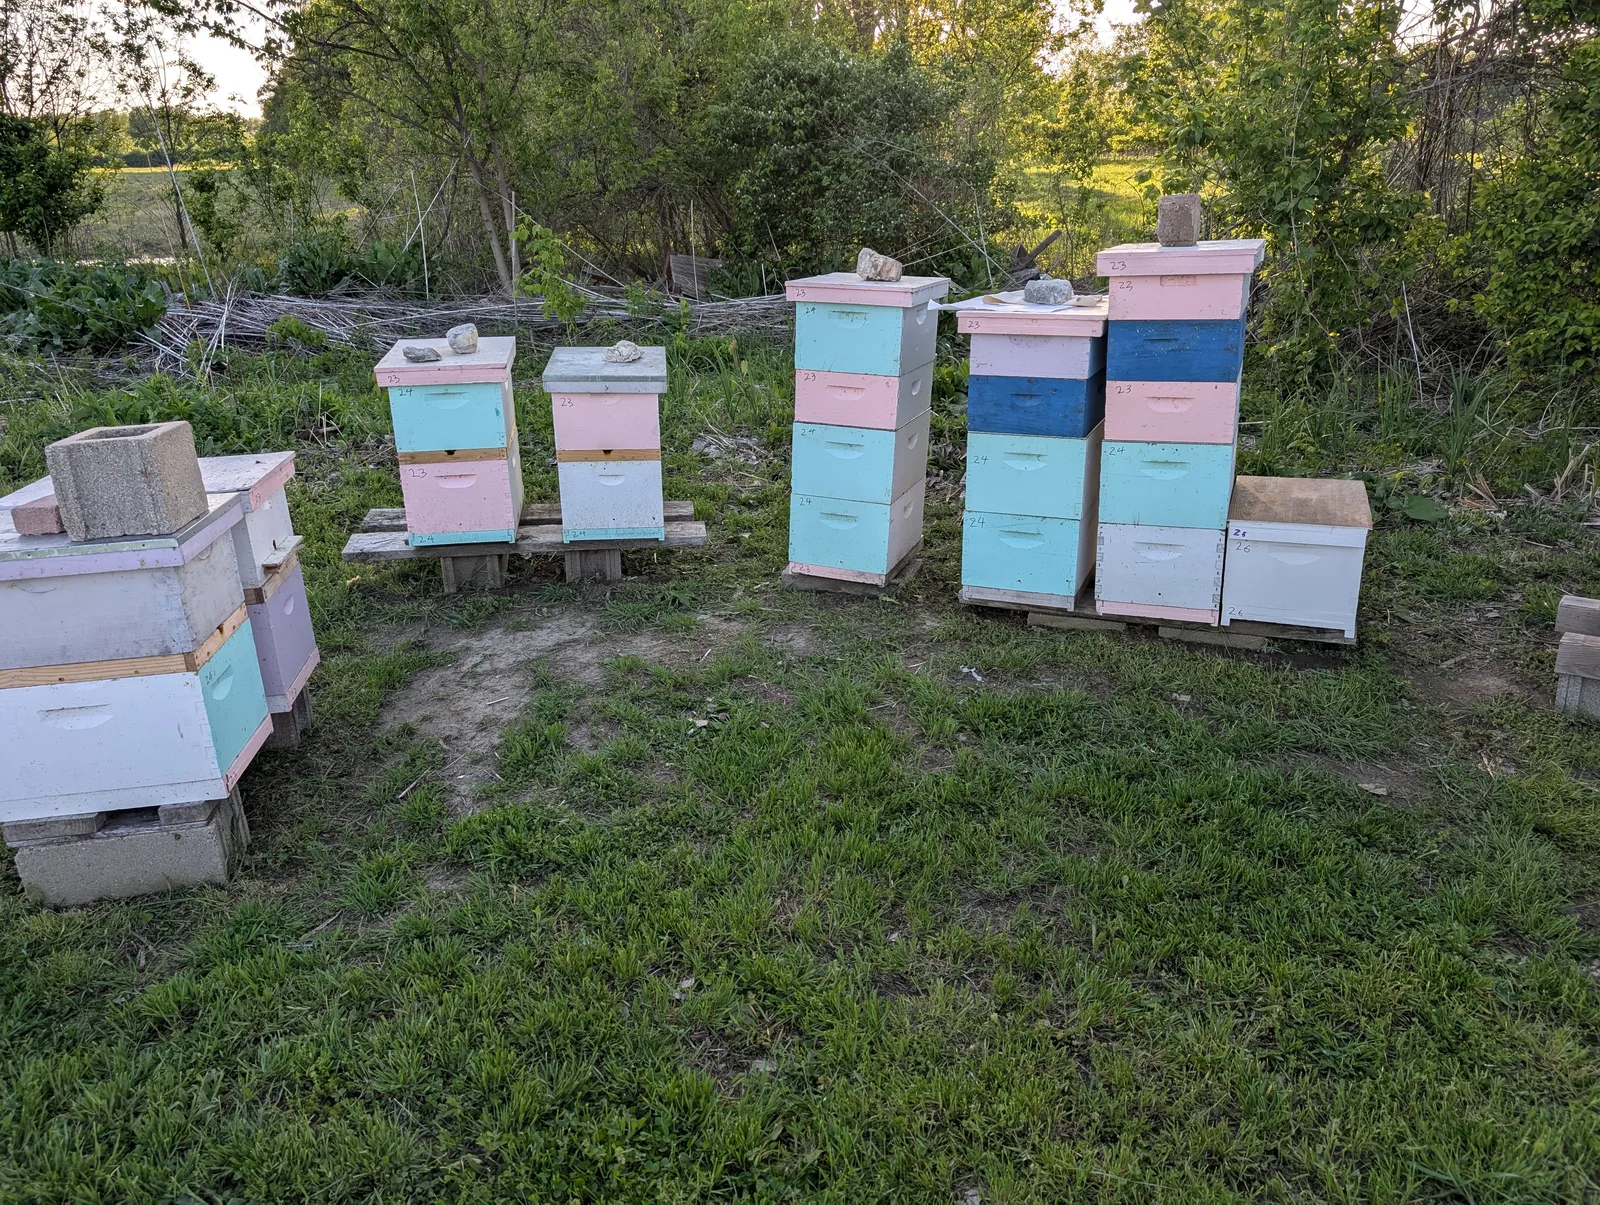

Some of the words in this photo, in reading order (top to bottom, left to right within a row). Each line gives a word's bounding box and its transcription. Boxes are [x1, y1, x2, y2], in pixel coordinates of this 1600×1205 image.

[1110, 260, 1127, 271] 23
[794, 288, 807, 298] 23
[967, 320, 981, 330] 23
[387, 374, 401, 384] 23
[803, 372, 816, 382] 23
[397, 387, 413, 397] 24
[1115, 384, 1132, 395] 23
[560, 397, 574, 408] 23
[801, 427, 816, 437] 24
[1108, 446, 1125, 456] 24
[973, 455, 989, 466] 24
[408, 467, 427, 479] 23
[799, 496, 812, 506] 24
[969, 516, 986, 528] 24
[418, 535, 435, 544] 24
[571, 530, 586, 539] 24
[1235, 541, 1251, 553] 26
[798, 564, 811, 574] 23
[1228, 606, 1243, 617] 26
